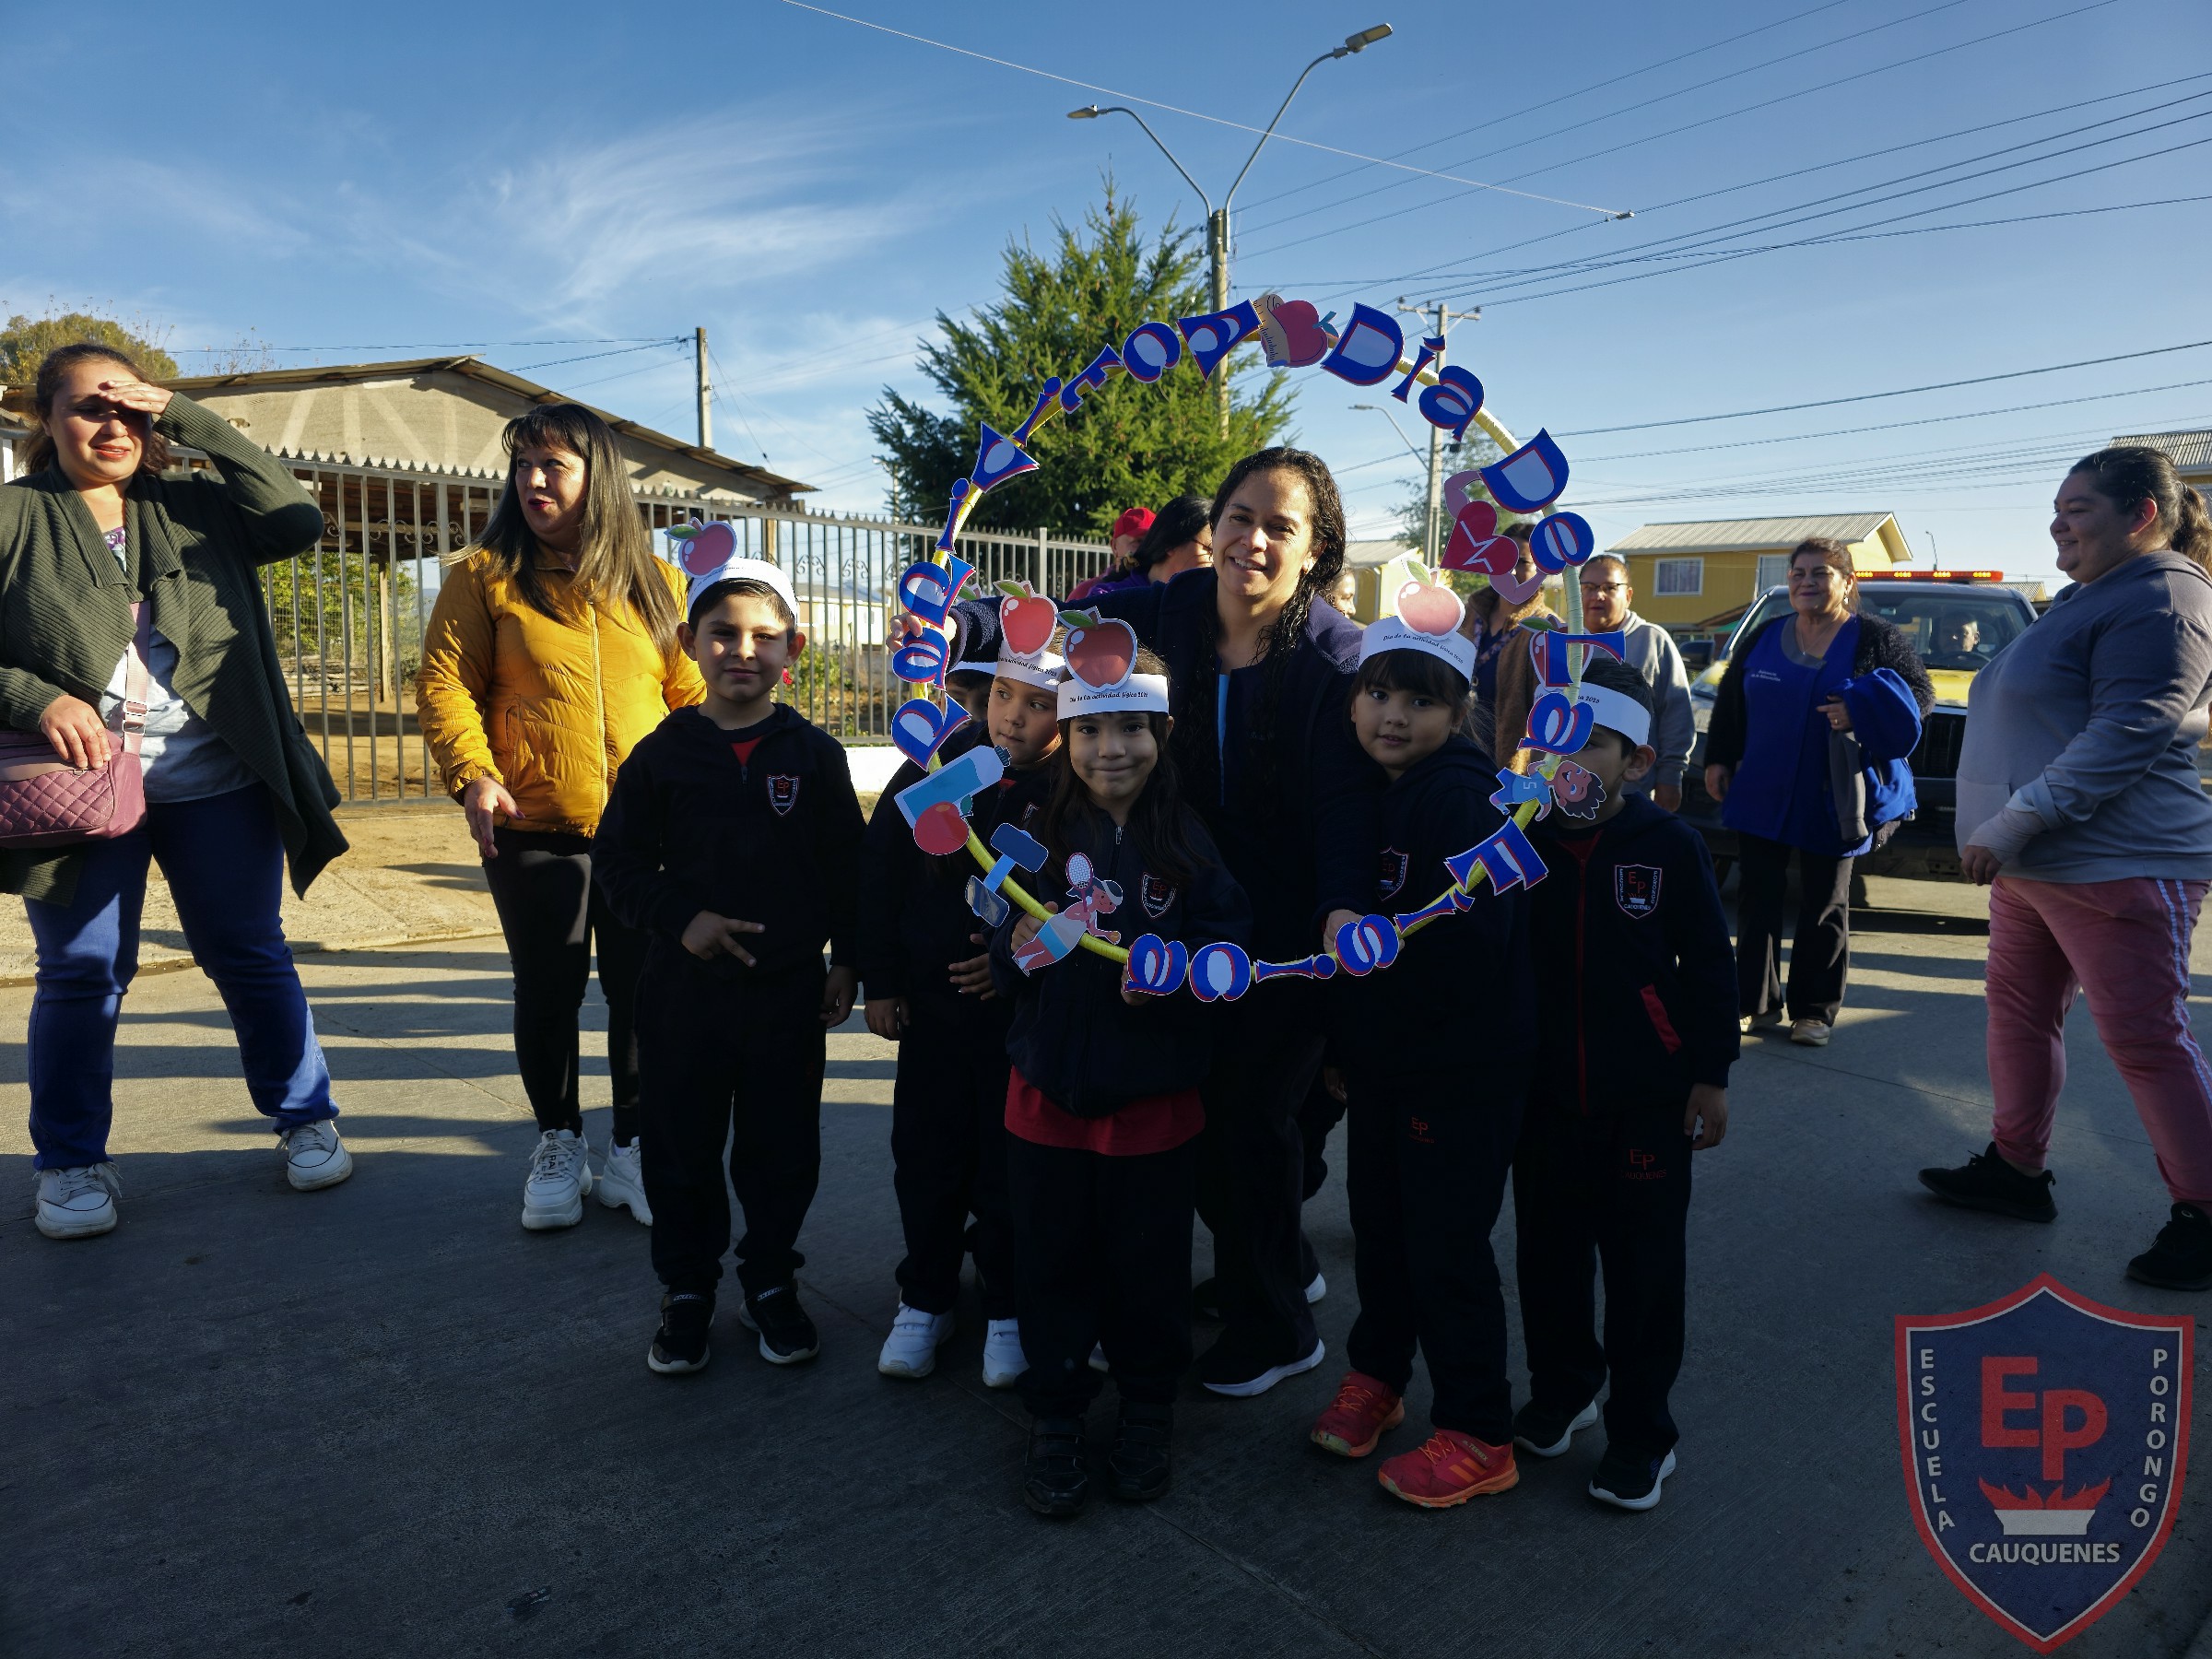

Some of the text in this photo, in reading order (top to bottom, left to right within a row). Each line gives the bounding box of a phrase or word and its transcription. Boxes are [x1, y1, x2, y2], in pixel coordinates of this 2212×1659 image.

[1321, 301, 1485, 442] Día
[1479, 427, 1594, 576] De
[1516, 629, 1627, 757] La
[1628, 871, 1647, 894] EP
[1629, 1148, 1657, 1171] EP
